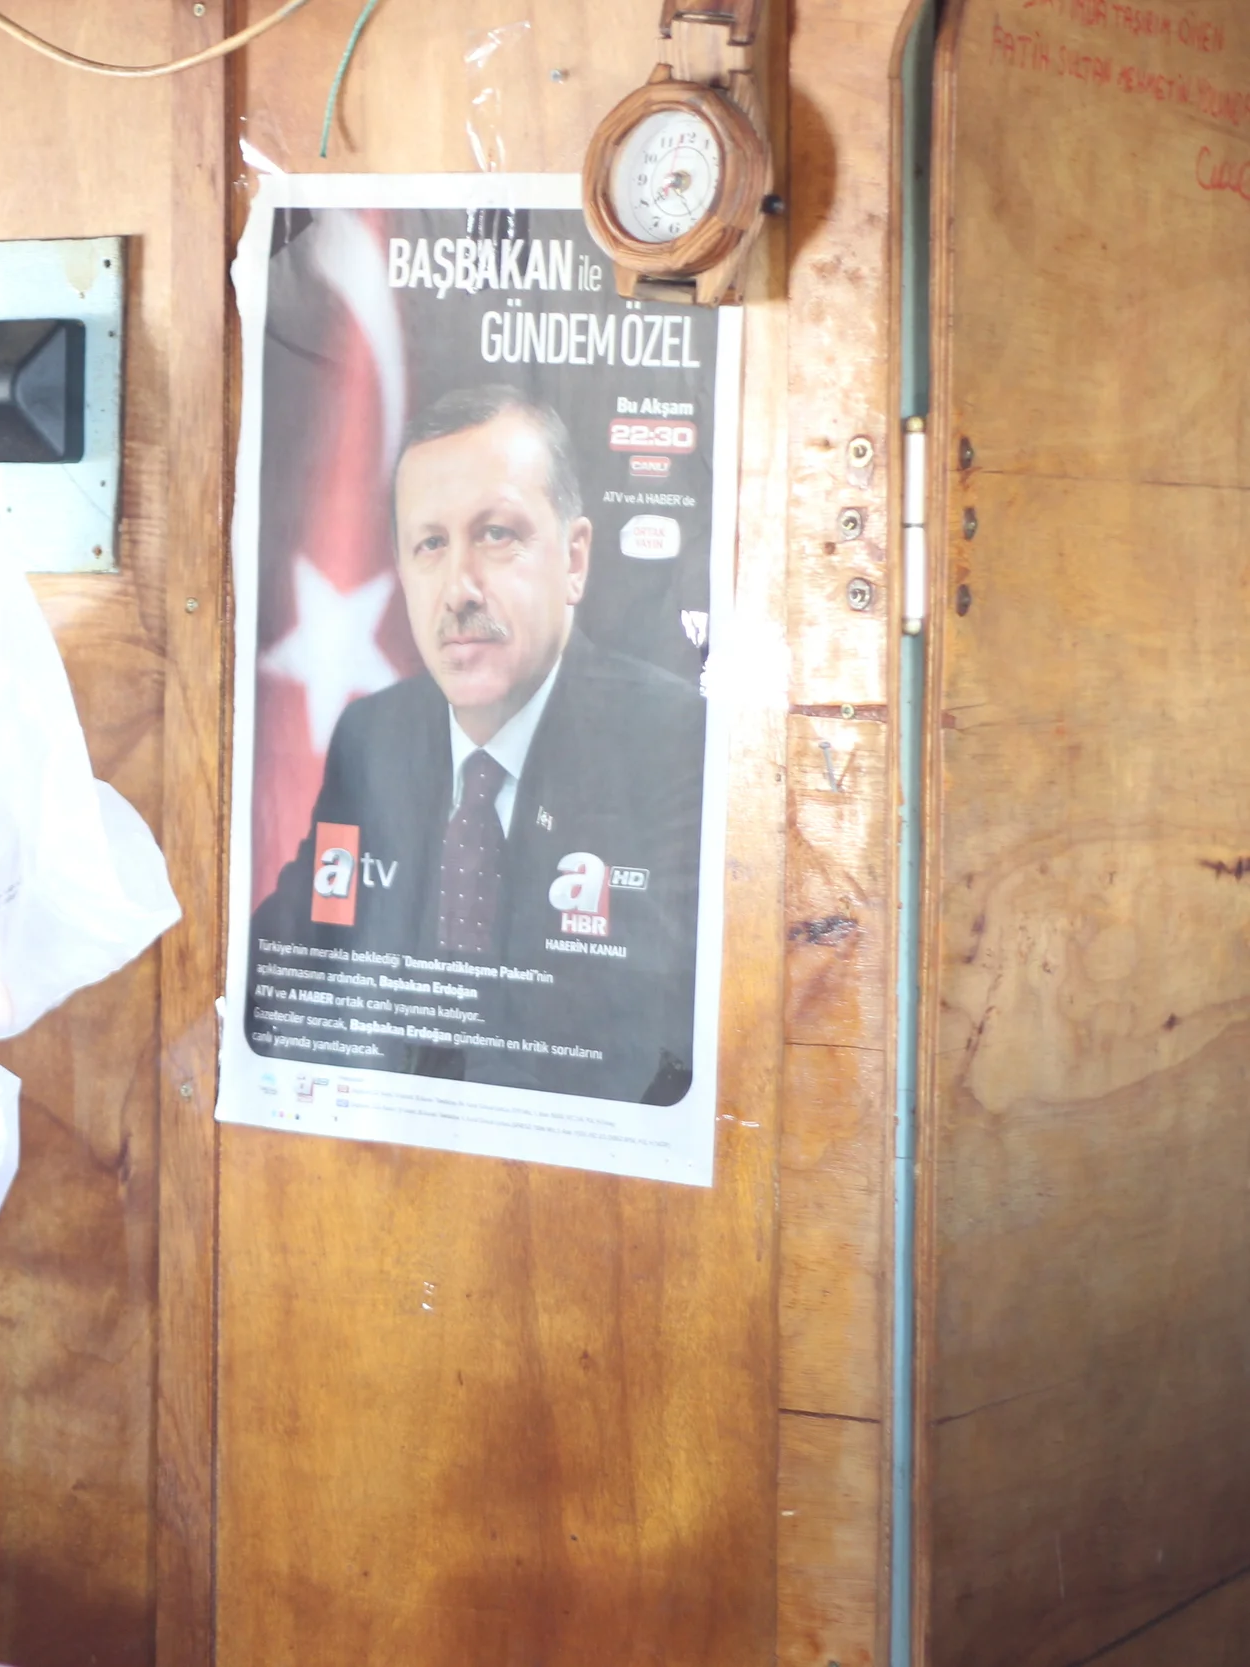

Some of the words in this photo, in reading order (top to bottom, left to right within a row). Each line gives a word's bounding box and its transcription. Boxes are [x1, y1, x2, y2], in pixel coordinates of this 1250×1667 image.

[388, 238, 573, 299] BAŞBAKAN
[578, 255, 602, 292] ile
[481, 298, 615, 366] GÜNDEM
[621, 301, 701, 368] ÖZEL
[617, 396, 637, 414] Bu
[640, 397, 694, 418] Akşam
[610, 424, 693, 448] 22:30
[603, 491, 623, 503] ATV
[624, 495, 636, 503] ve
[612, 870, 645, 887] HD
[561, 912, 607, 935] HBR
[310, 947, 349, 960] merakla
[590, 943, 627, 958] KANALI
[255, 983, 274, 998] ATV
[275, 989, 287, 999] ve
[288, 988, 297, 1001] A
[298, 989, 334, 1006] HABER
[335, 996, 364, 1009] ortak
[378, 975, 431, 992] Başbakan
[432, 981, 478, 999] Erdoğan
[350, 1018, 405, 1037] Başbakan
[406, 1024, 452, 1044] Erdoğan
[507, 1039, 520, 1050] en
[522, 1039, 549, 1053] kritik
